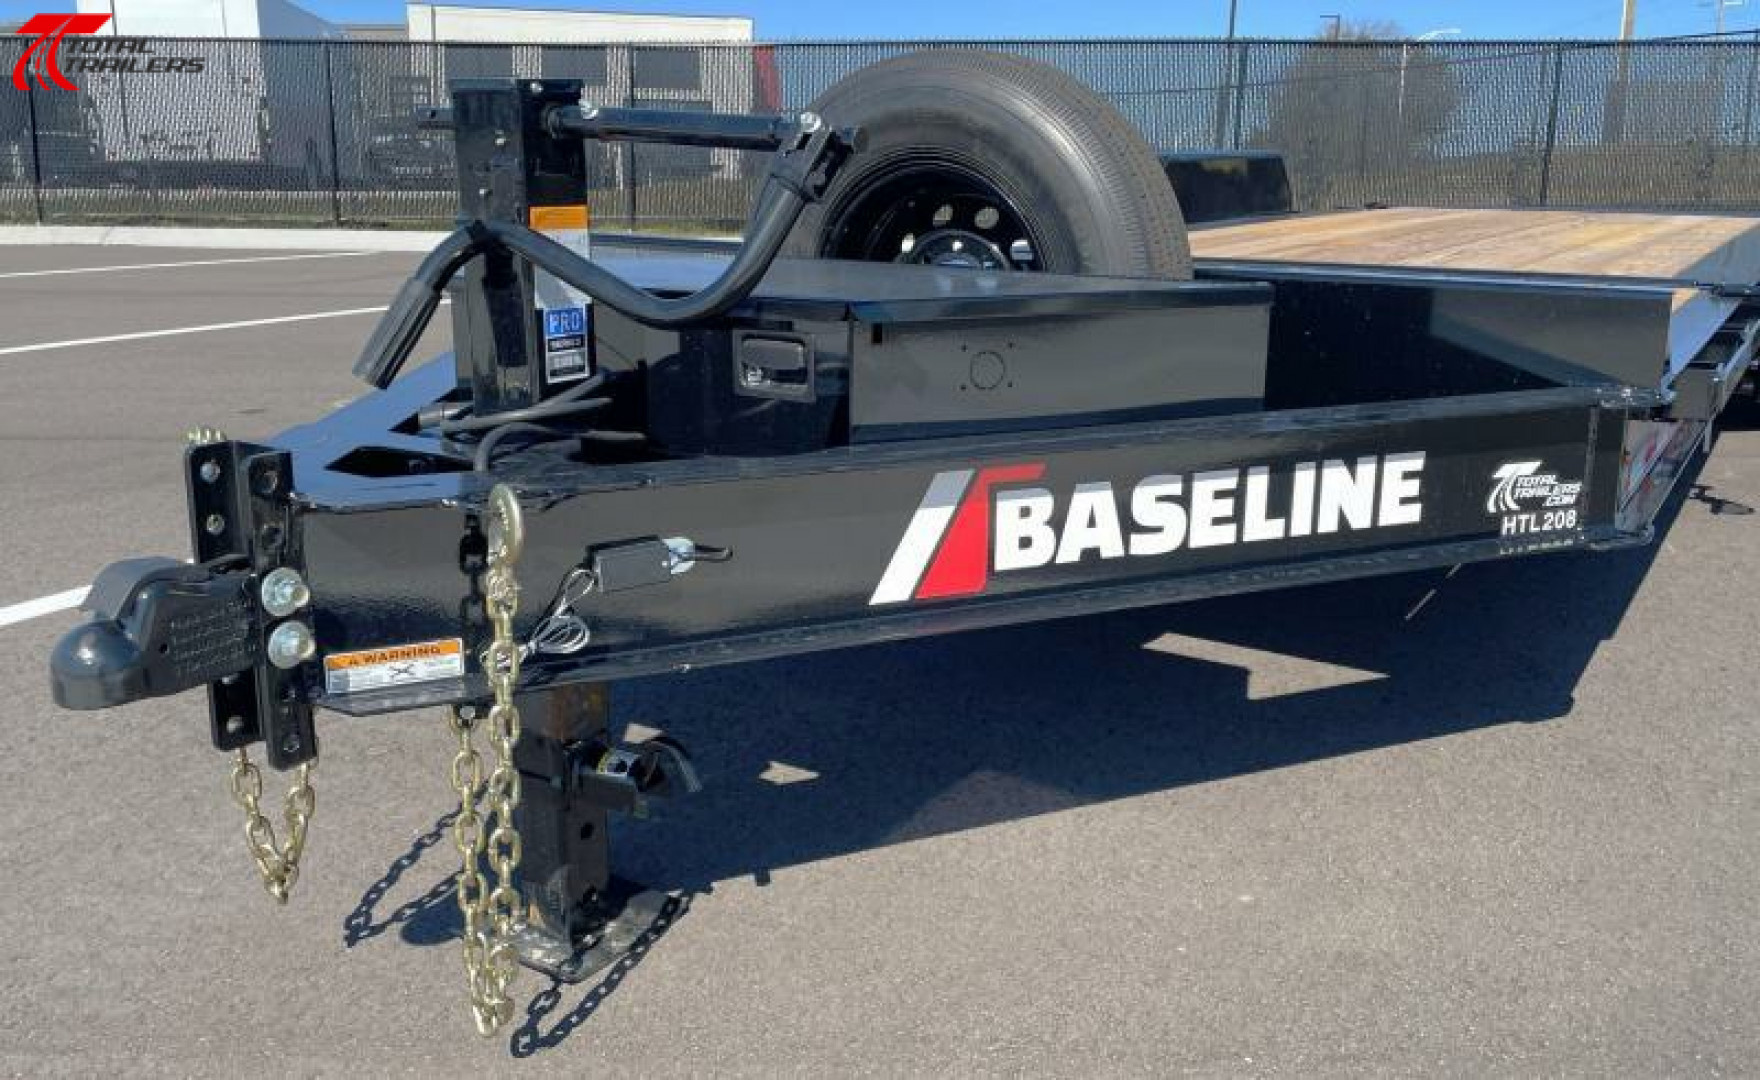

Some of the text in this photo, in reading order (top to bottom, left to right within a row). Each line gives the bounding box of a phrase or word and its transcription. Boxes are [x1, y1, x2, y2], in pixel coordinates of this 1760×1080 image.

[993, 450, 1427, 572] BASELINE
[1502, 509, 1577, 536] HTL208
[364, 645, 441, 664] WARNING
